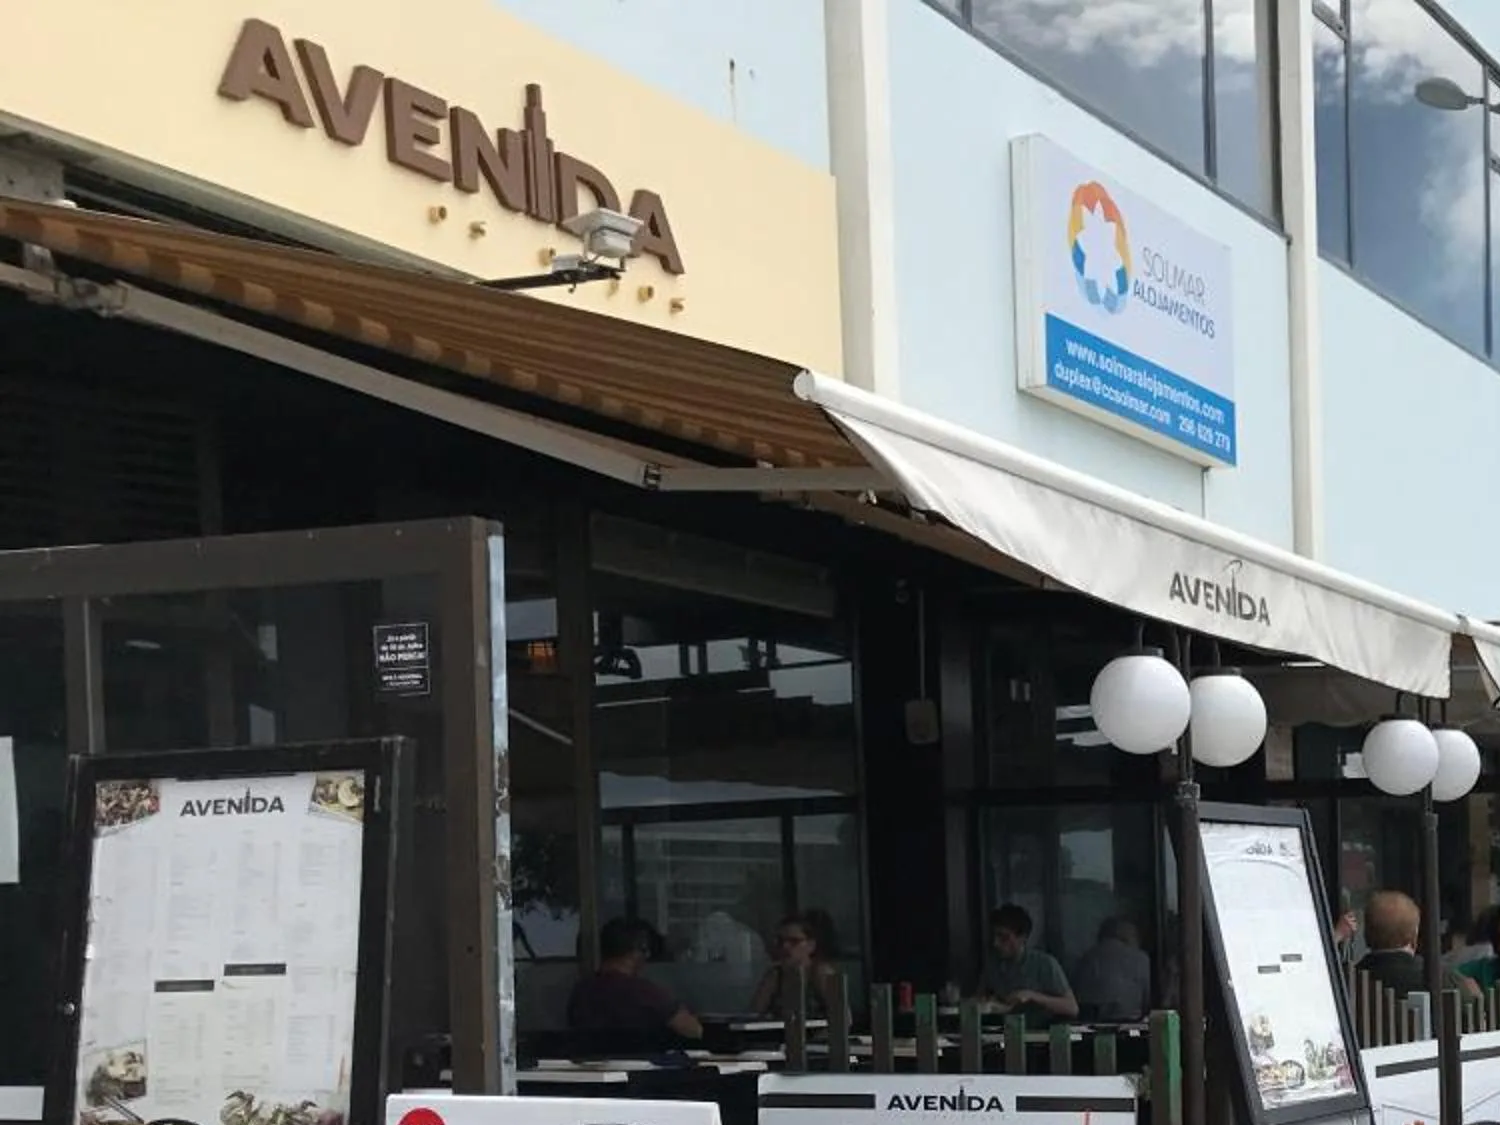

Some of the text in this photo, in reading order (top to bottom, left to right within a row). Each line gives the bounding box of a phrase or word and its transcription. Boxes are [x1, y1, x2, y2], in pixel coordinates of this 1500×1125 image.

[217, 18, 685, 275] AVENIDA
[1142, 247, 1208, 304] SOLMAR
[1133, 280, 1216, 340] ALOJAMENTOS
[1168, 566, 1272, 627] AVENIDA
[179, 787, 285, 817] AVENIDA
[886, 1085, 1005, 1113] AVENIDA
